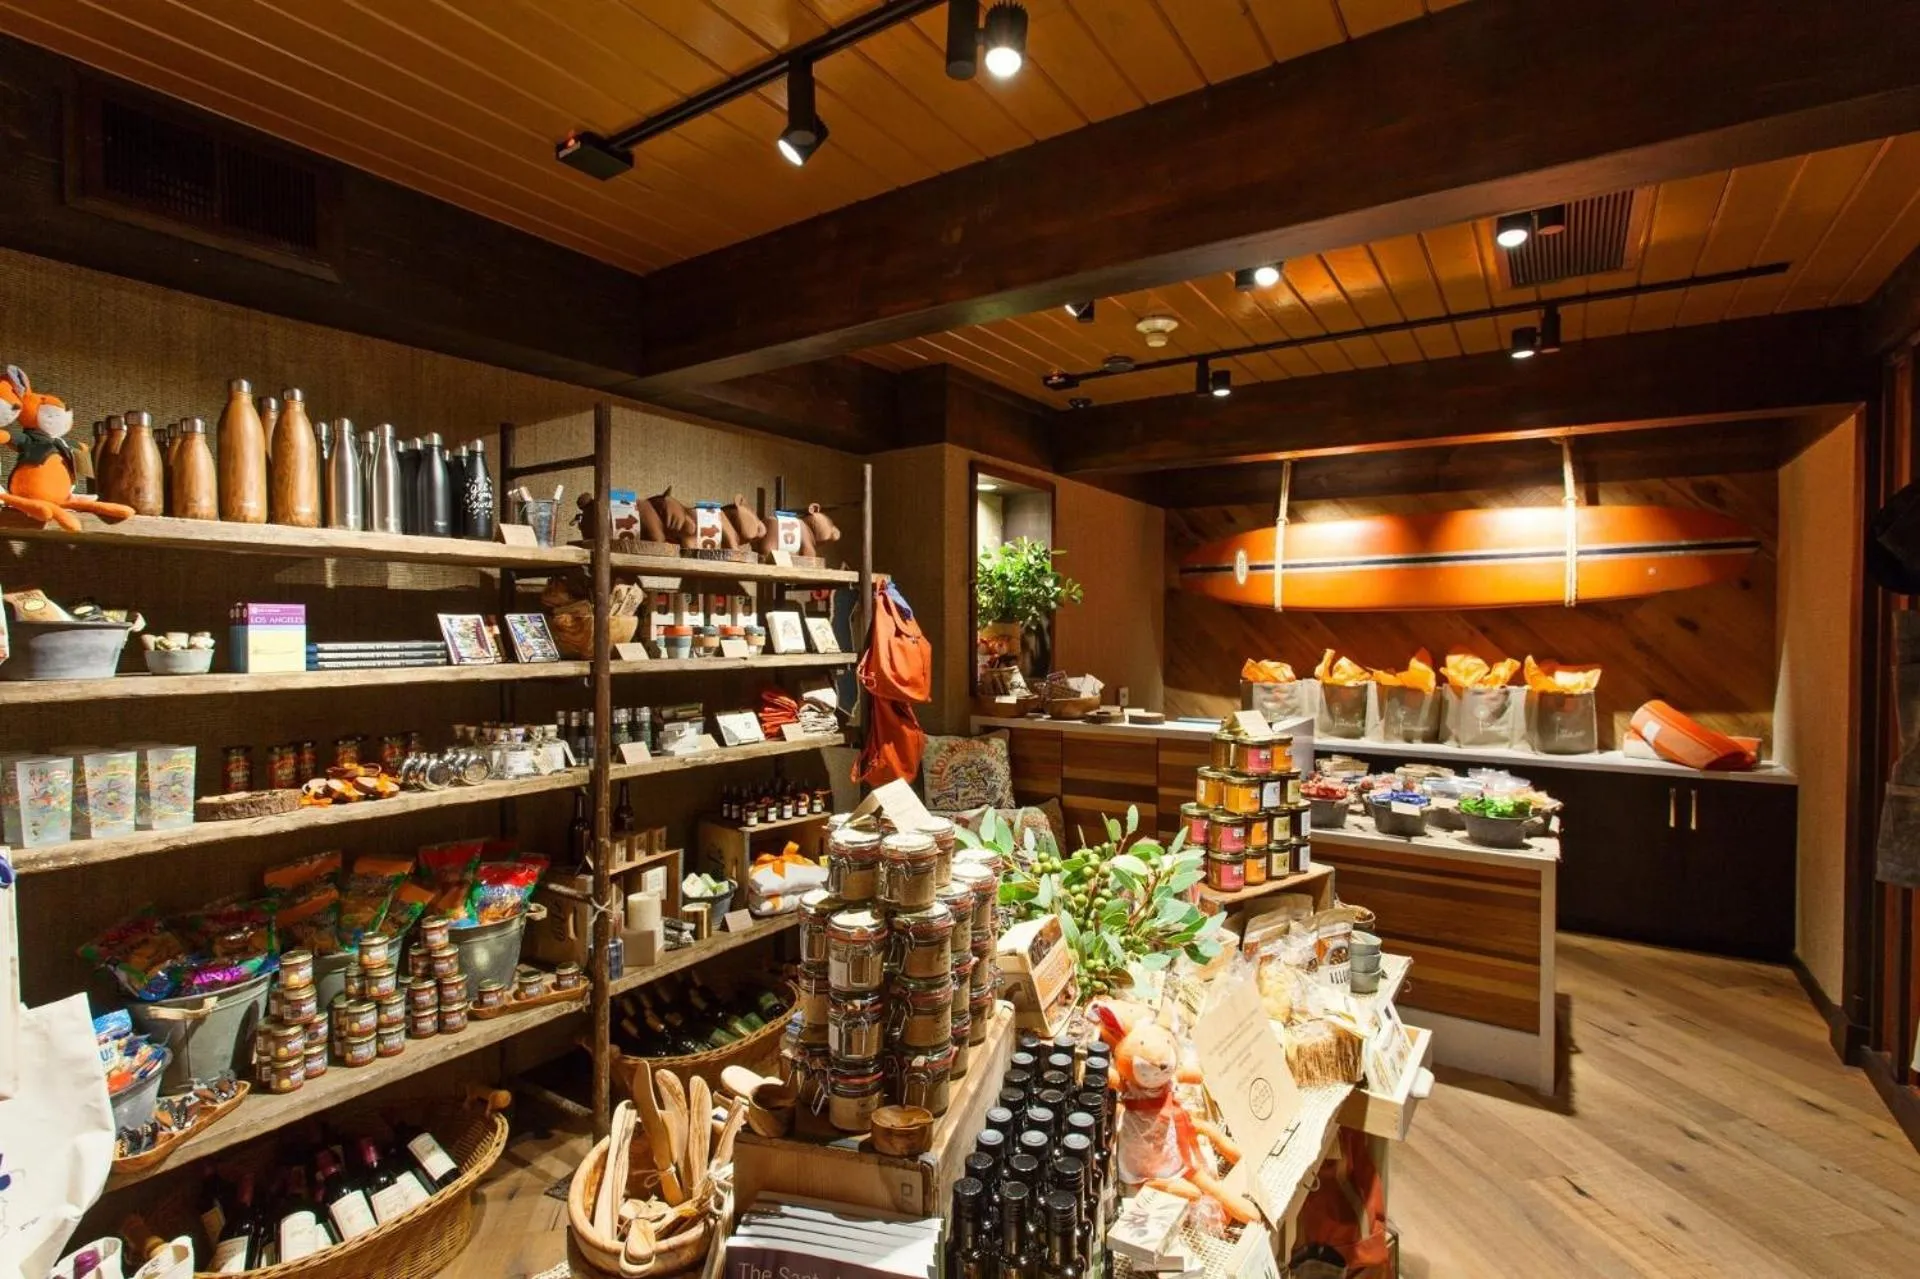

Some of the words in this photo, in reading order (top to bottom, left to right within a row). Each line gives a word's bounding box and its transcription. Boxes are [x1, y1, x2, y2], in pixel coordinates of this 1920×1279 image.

[250, 616, 267, 624] LOS
[269, 616, 303, 624] ANGELES
[738, 1262, 771, 1279] The
